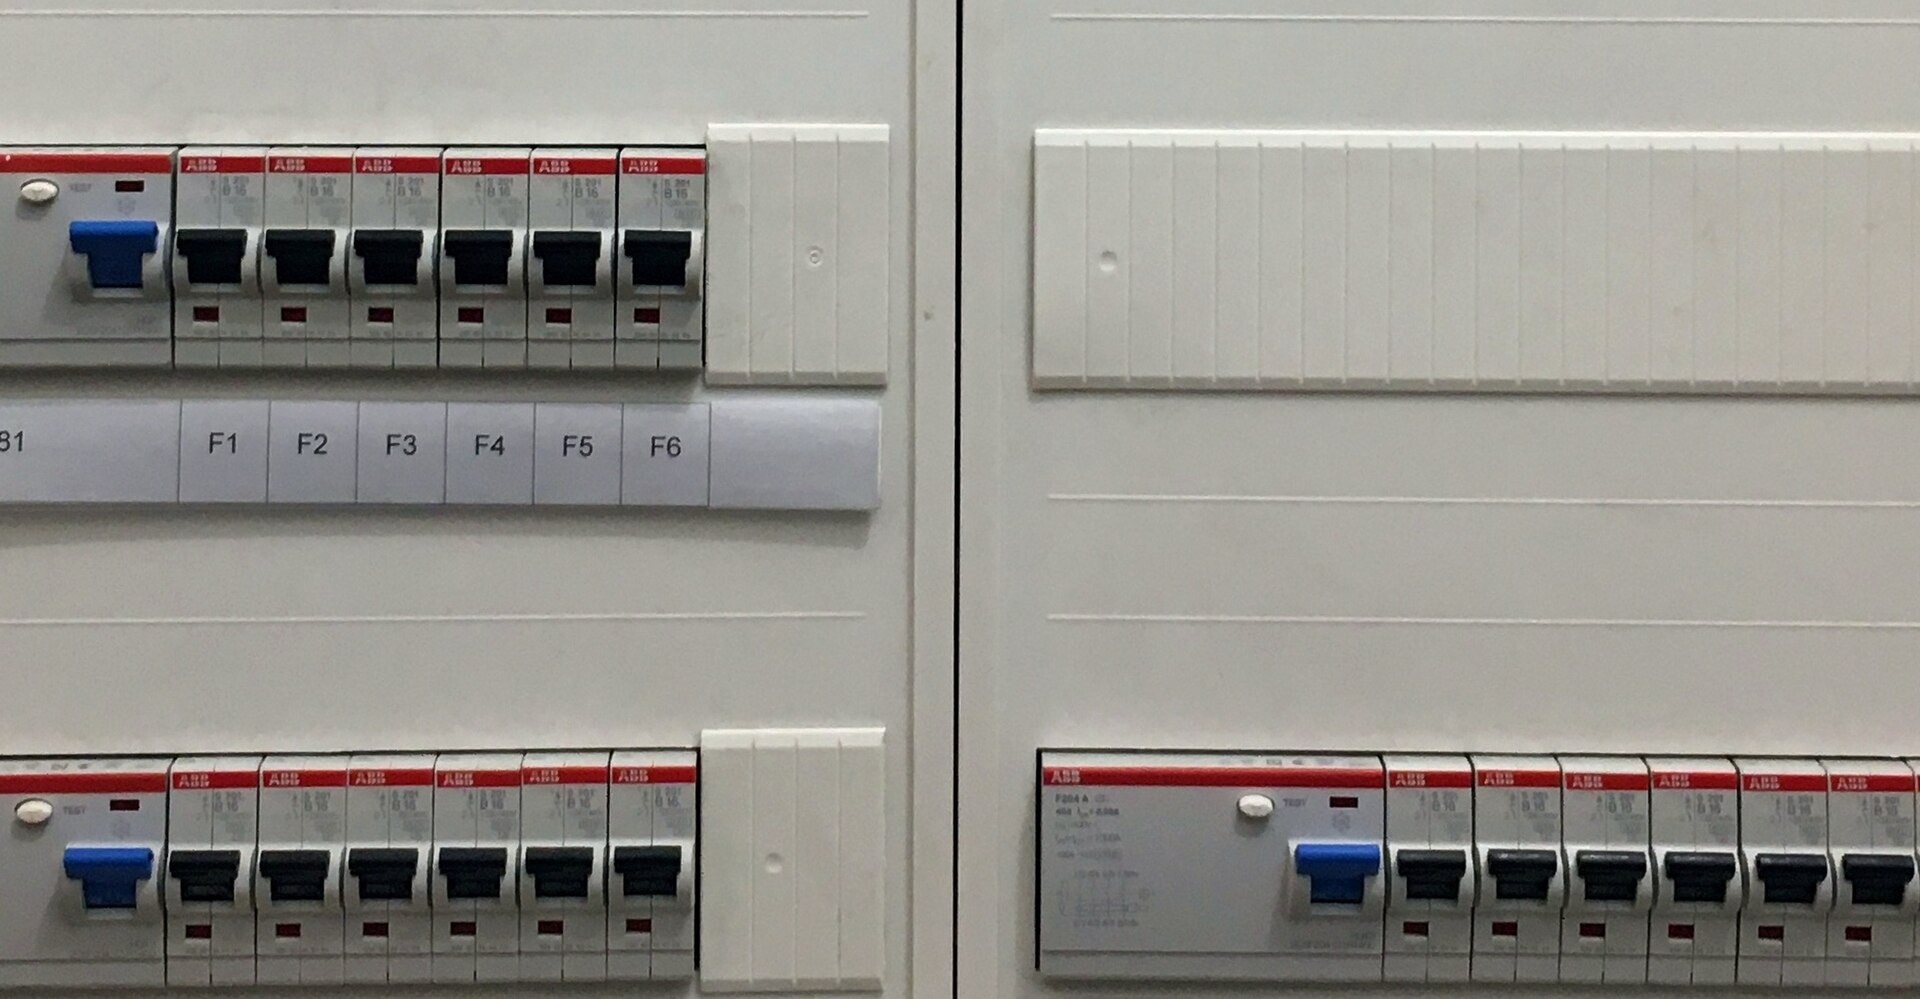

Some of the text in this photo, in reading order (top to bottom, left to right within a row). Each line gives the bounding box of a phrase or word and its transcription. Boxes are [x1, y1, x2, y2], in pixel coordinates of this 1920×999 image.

[186, 159, 217, 171] ABB
[275, 159, 305, 171] ABB
[362, 160, 393, 172] ABB
[451, 160, 482, 172] ABB
[539, 160, 570, 172] ABB
[628, 160, 658, 172] ABB
[676, 188, 688, 199] 16
[209, 432, 236, 453] F1
[298, 433, 327, 455] F2
[387, 434, 416, 455] F3
[475, 435, 505, 456] F4
[563, 436, 593, 457] F5
[651, 436, 682, 457] F6
[179, 773, 210, 787] ABB
[269, 772, 300, 786] ABB
[356, 771, 386, 785] ABB
[443, 772, 474, 786] ABB
[530, 769, 560, 783] ABB
[618, 769, 649, 782] ABB
[1051, 769, 1080, 783] ABB
[1395, 773, 1426, 786] ABB
[1484, 772, 1515, 785] ABB
[1573, 775, 1603, 788] ABB
[1660, 774, 1690, 787] ABB
[1750, 776, 1780, 789] ABB
[1837, 777, 1868, 790] ABB
